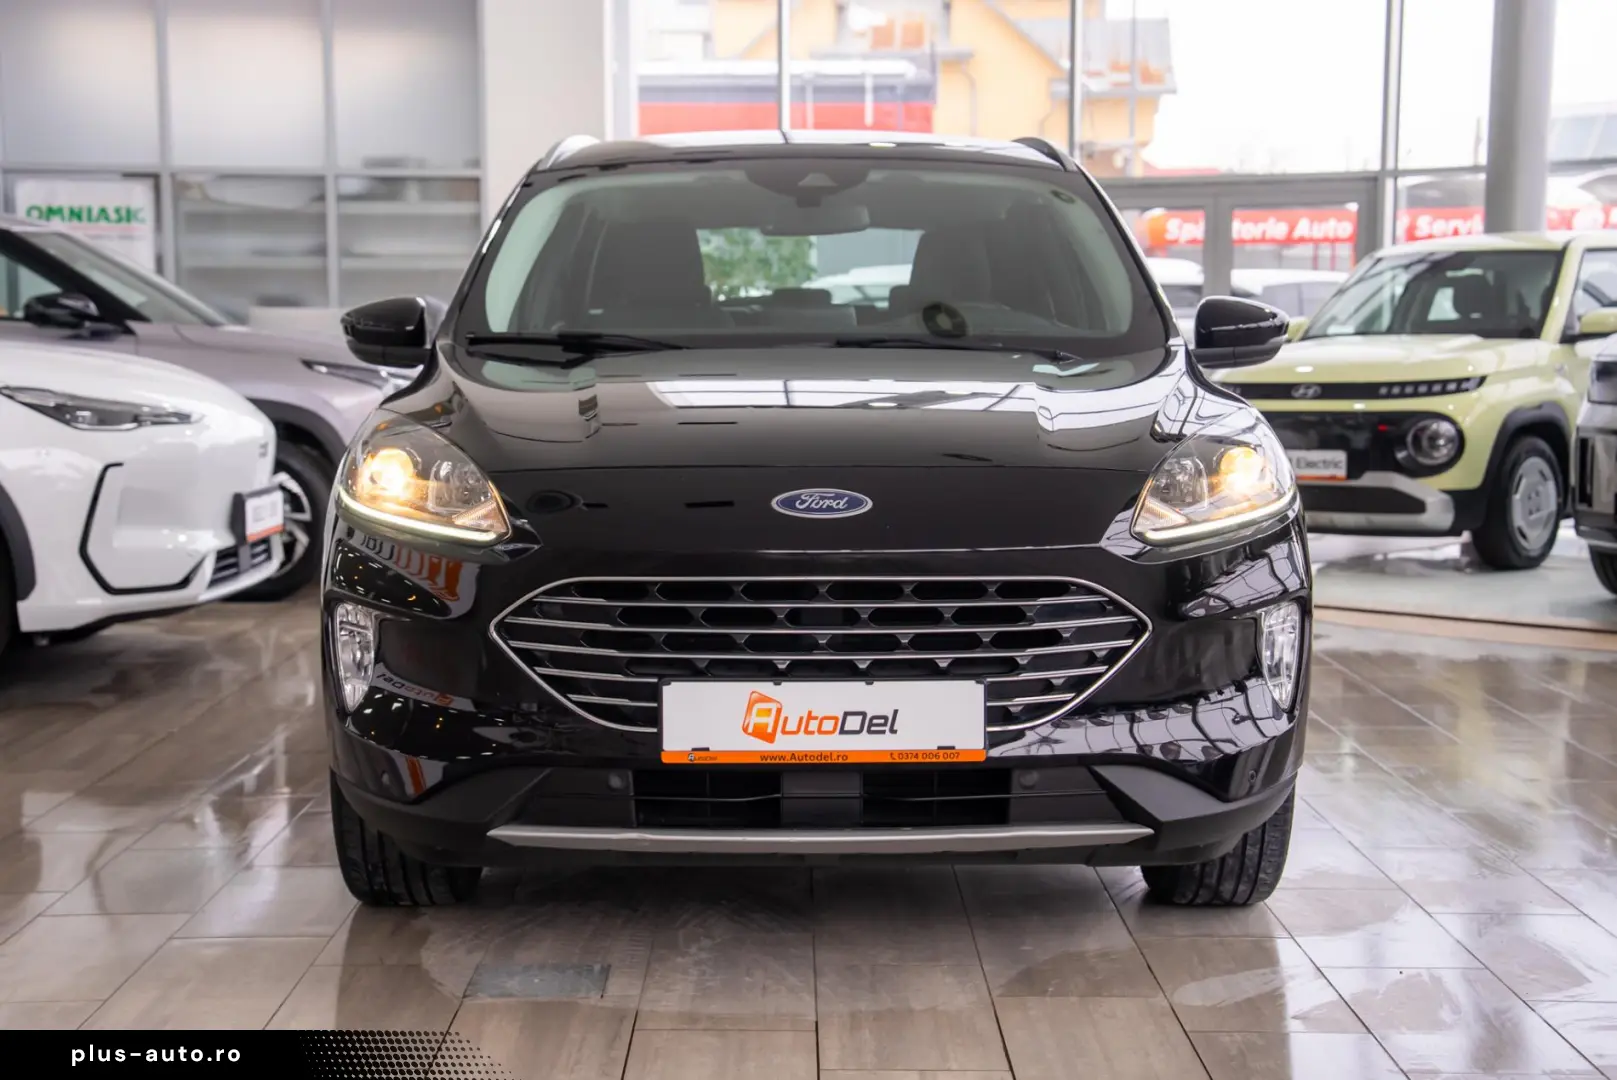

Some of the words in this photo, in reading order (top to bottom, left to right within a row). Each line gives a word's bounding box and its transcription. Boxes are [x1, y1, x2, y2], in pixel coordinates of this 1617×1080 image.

[1165, 217, 1288, 243] Sptorie
[1294, 216, 1353, 240] Auto
[1415, 214, 1484, 238] Servi
[795, 493, 849, 510] Ford
[745, 698, 899, 738] AutoDel
[760, 752, 849, 762] www.Autodel.ro
[897, 752, 919, 761] 0374
[921, 752, 940, 761] 006
[942, 751, 960, 761] 007
